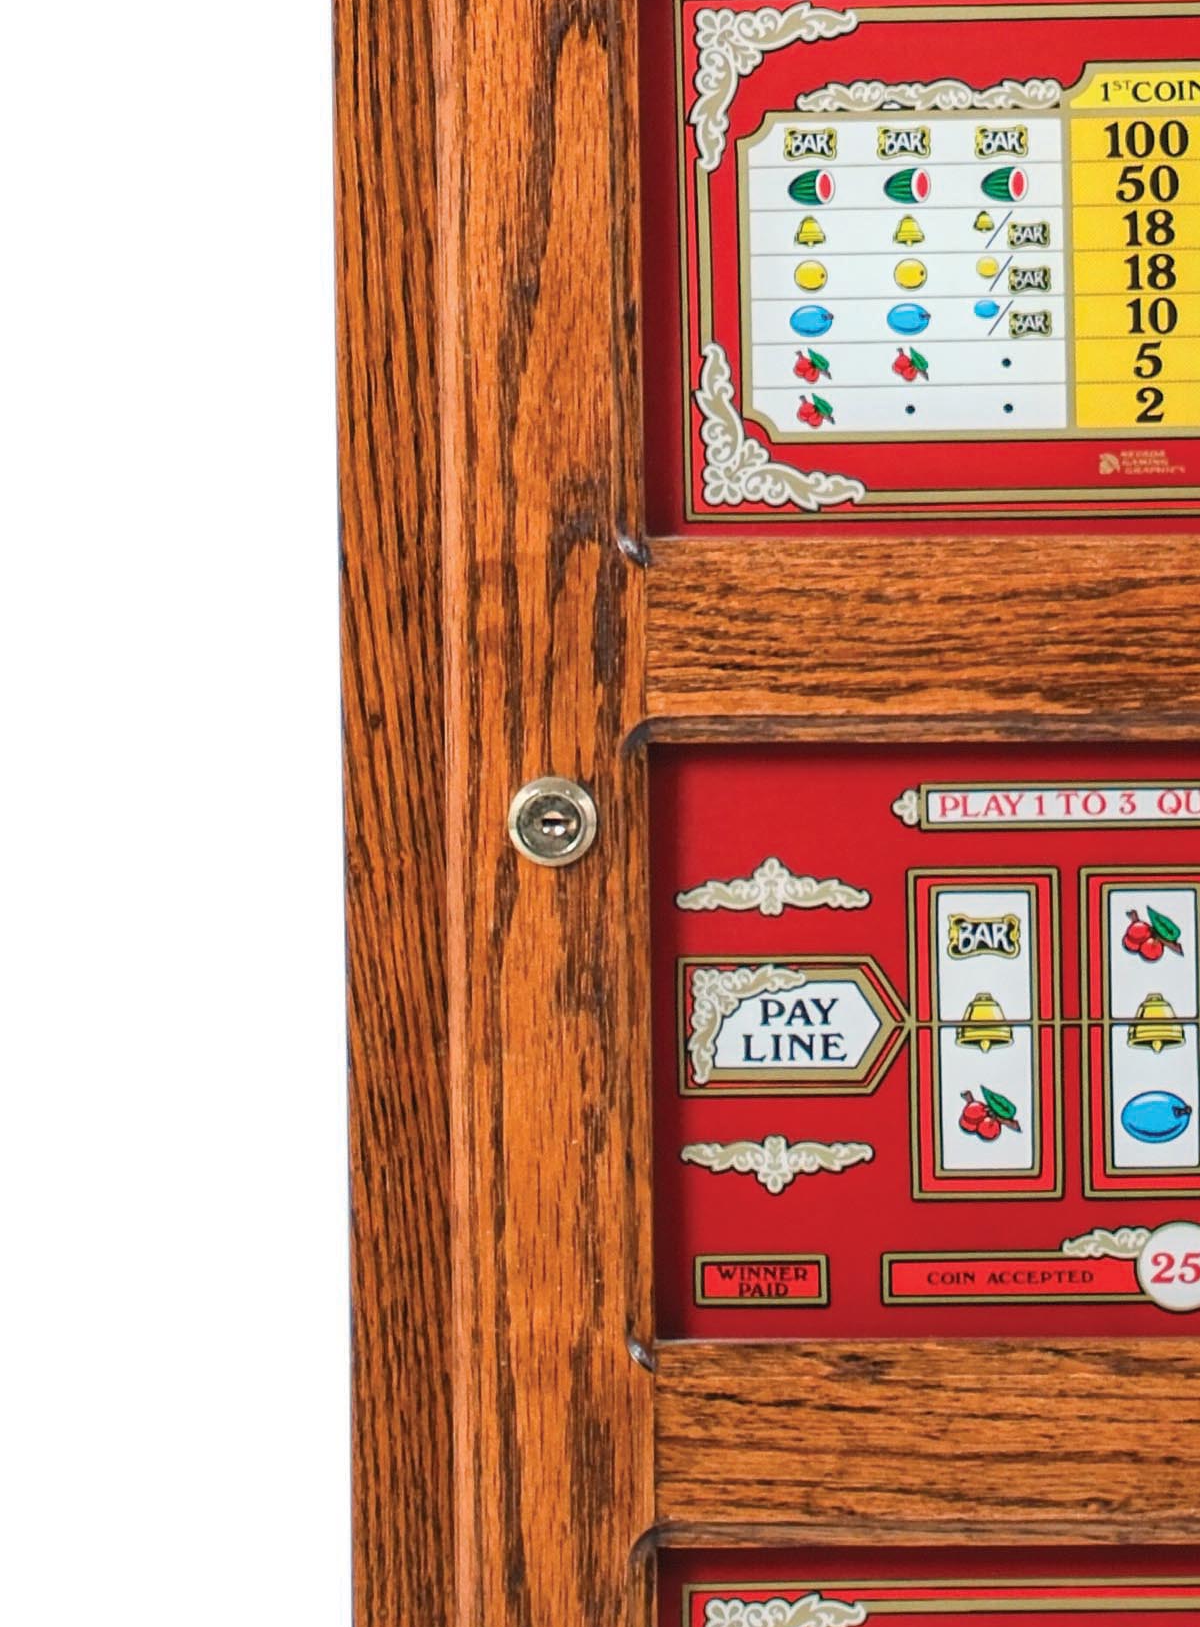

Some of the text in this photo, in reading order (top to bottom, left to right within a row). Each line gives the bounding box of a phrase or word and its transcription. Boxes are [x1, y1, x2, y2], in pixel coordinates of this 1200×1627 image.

[791, 132, 831, 156] BAR
[884, 132, 924, 155] BAR
[982, 130, 1022, 154] BAR
[1104, 120, 1189, 159] 100
[1115, 165, 1179, 203] 50
[1013, 225, 1046, 246] BAR
[1122, 208, 1176, 247] 18
[1014, 270, 1046, 290] BAR
[1123, 253, 1177, 291] 18
[1014, 314, 1047, 335] BAR
[1126, 297, 1179, 335] 10
[1133, 341, 1164, 379] 5
[1135, 386, 1165, 424] 2
[939, 791, 1024, 818] PLAY
[1034, 792, 1045, 816] 1
[1056, 790, 1107, 815] TO
[1119, 791, 1137, 815] 3
[958, 922, 1008, 954] BAR
[760, 998, 839, 1026] PAY
[742, 1032, 848, 1062] LINE
[717, 1264, 809, 1282] WINNER
[738, 1282, 789, 1298] PAID
[927, 1270, 1095, 1287] COIN ACCEPTED
